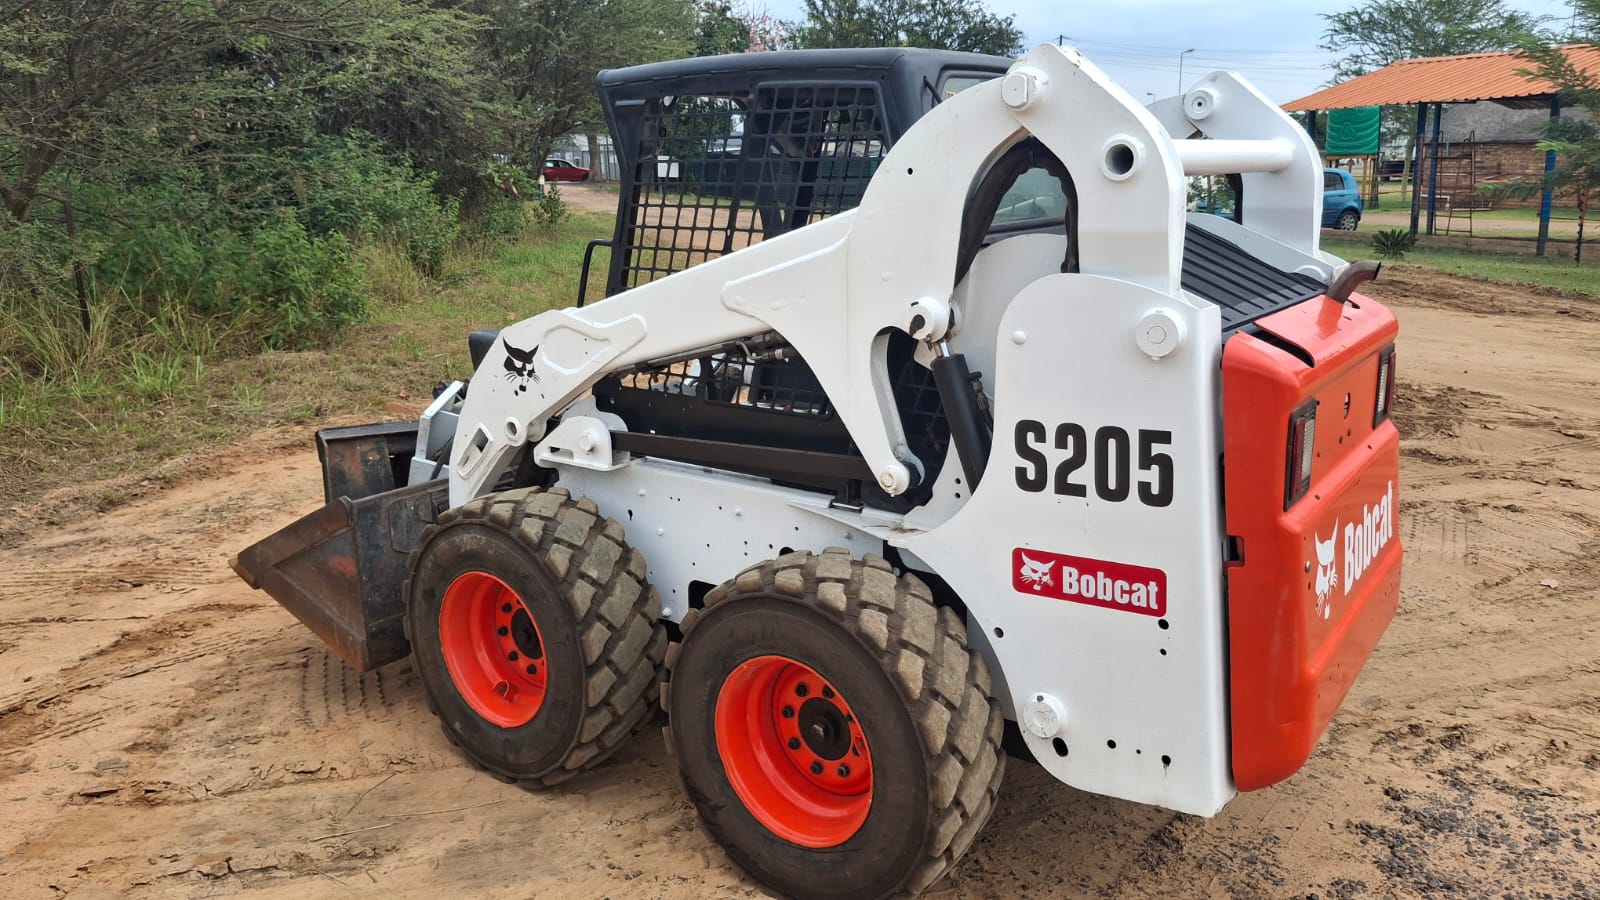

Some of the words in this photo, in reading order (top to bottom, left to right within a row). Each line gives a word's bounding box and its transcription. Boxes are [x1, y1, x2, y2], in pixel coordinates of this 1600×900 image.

[1014, 419, 1174, 507] S205
[1344, 480, 1392, 595] Bobcat
[1062, 565, 1158, 610] Bobcat
